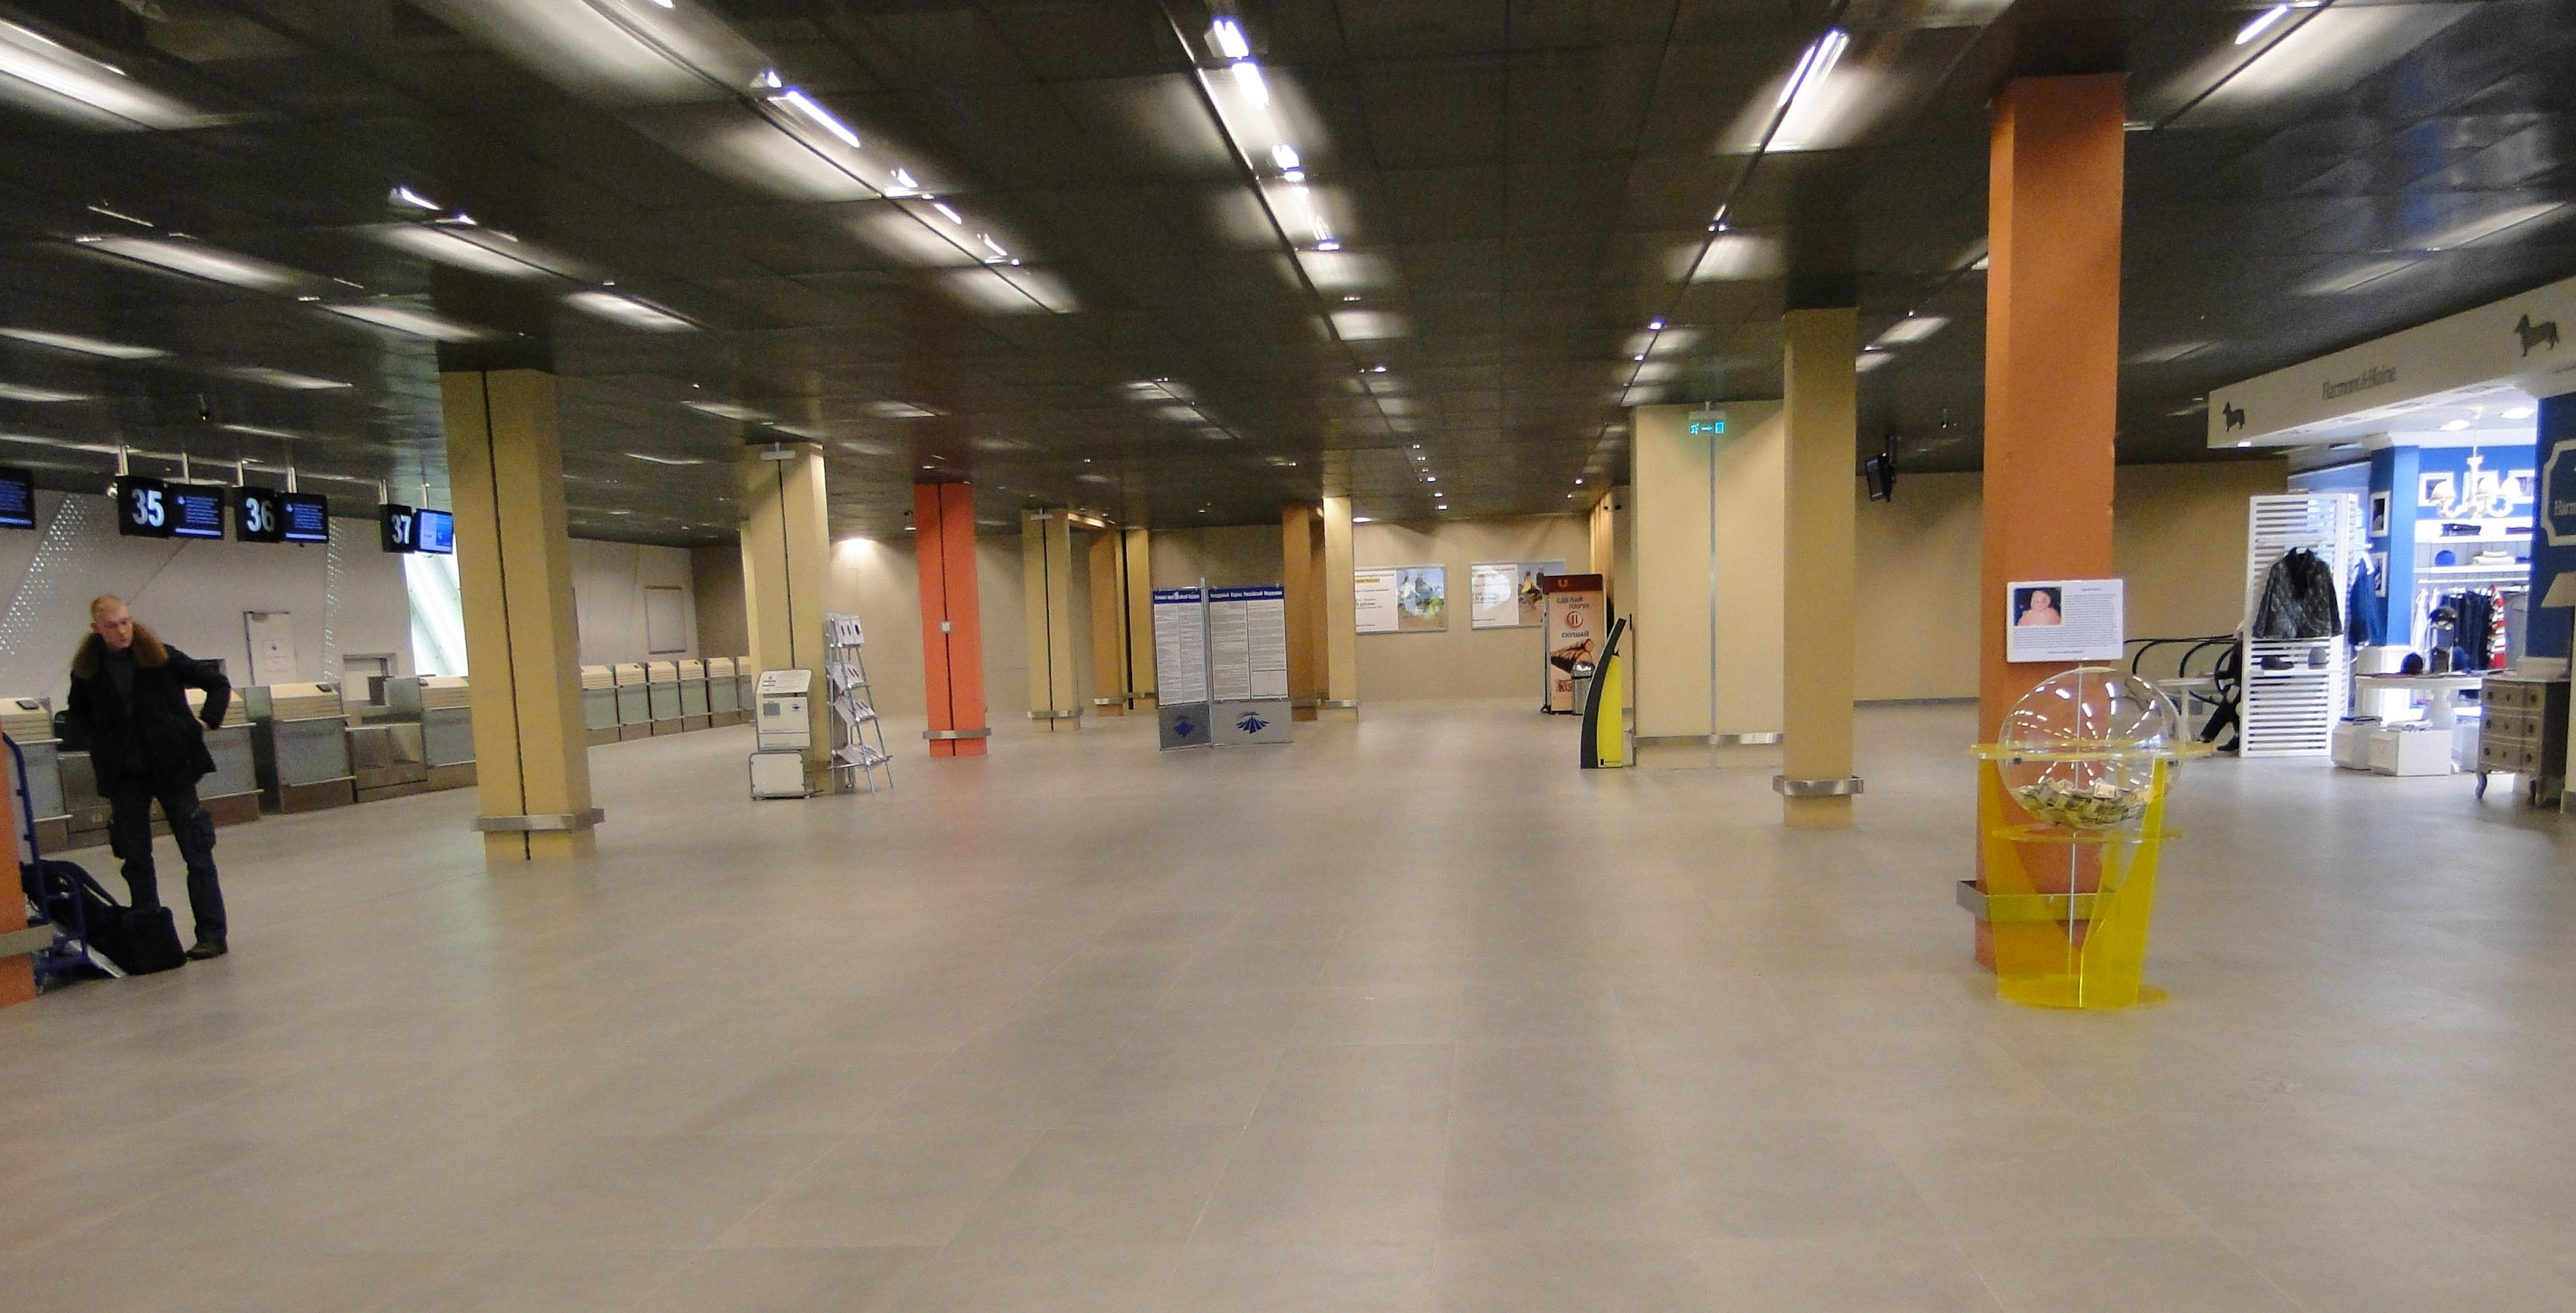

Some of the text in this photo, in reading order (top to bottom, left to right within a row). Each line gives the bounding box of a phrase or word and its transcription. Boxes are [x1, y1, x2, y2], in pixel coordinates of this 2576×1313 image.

[132, 488, 165, 527] 35
[246, 497, 276, 533] 36
[391, 513, 412, 545] 37
